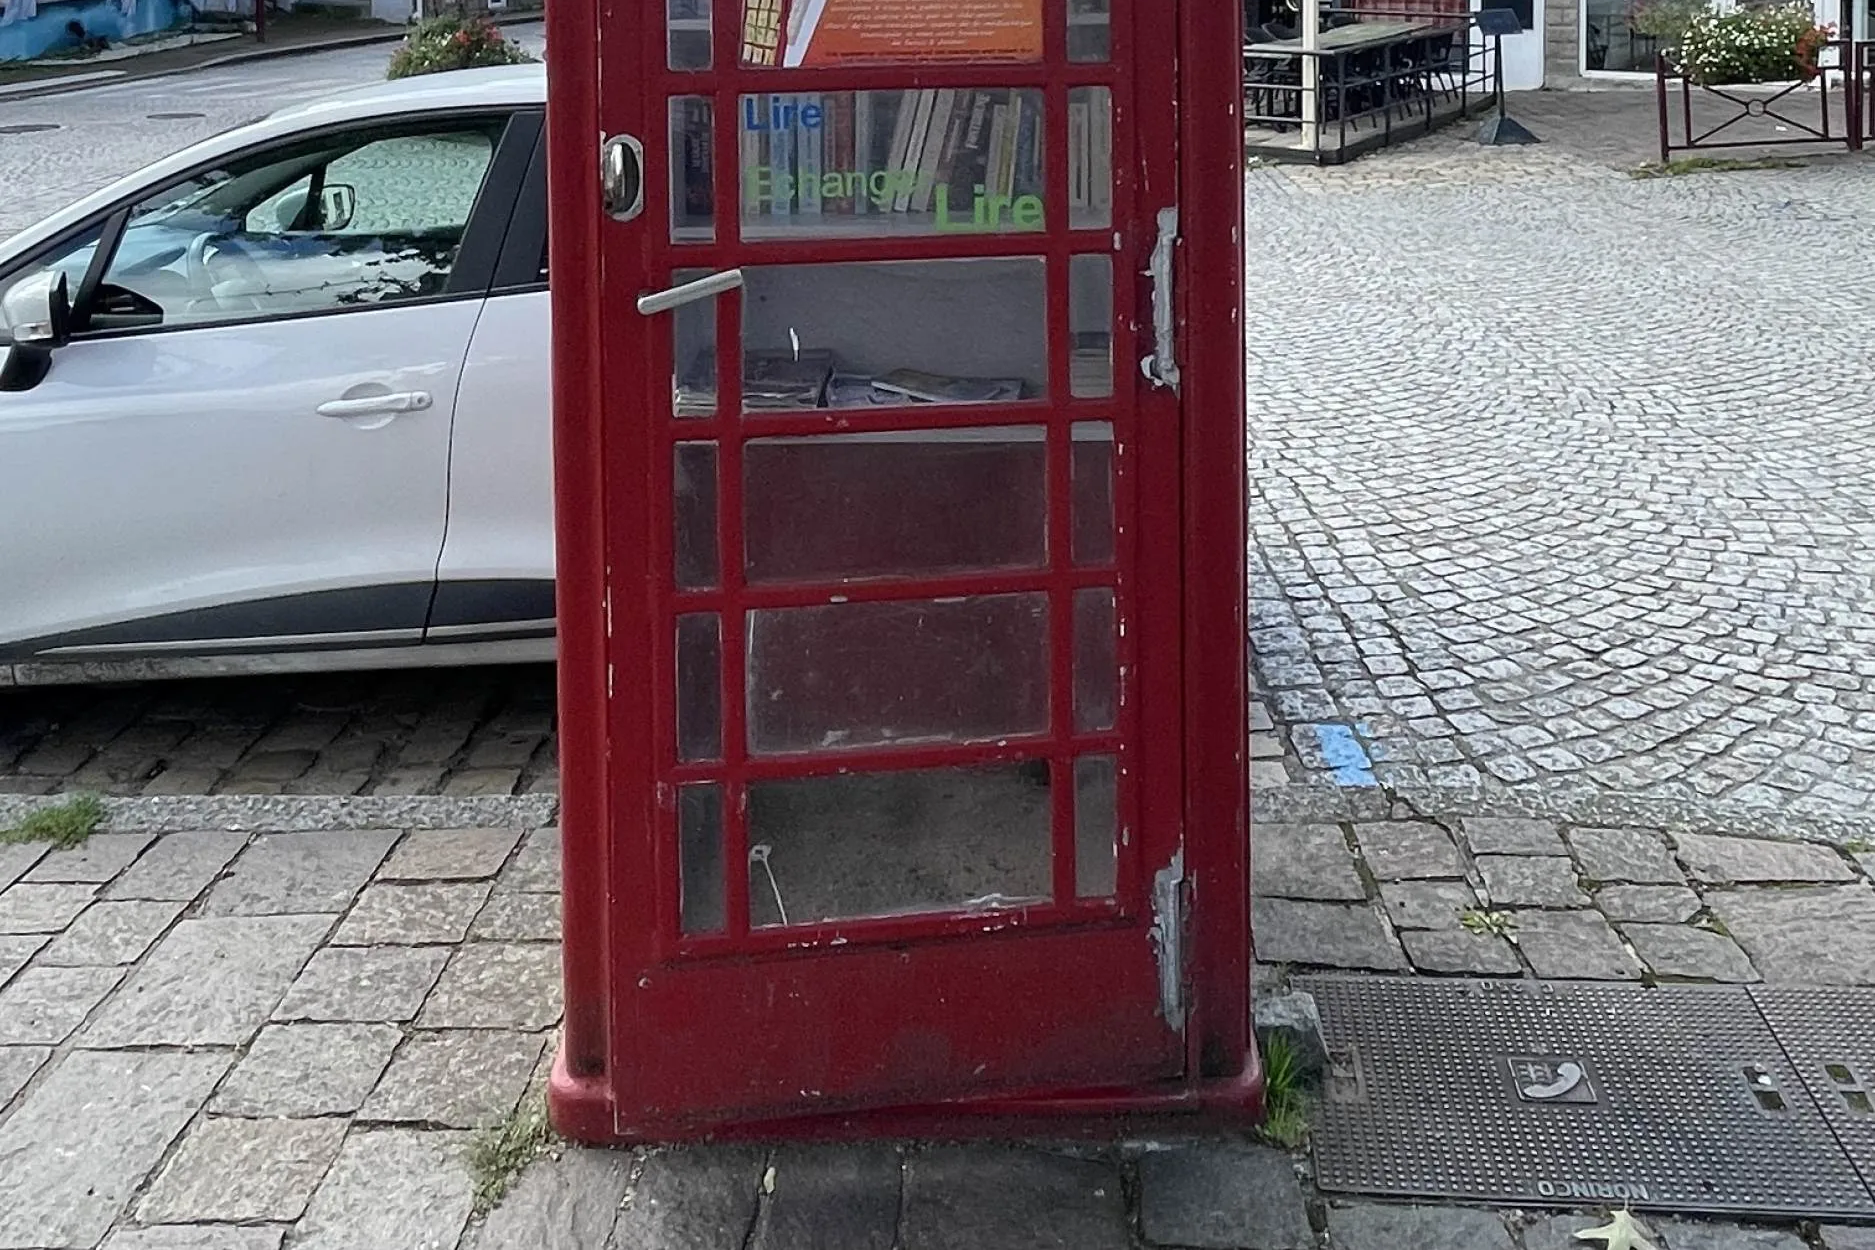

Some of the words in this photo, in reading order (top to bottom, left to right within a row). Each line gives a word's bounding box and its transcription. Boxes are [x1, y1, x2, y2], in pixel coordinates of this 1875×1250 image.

[746, 96, 823, 130] Lire
[935, 182, 1045, 231] Lire
[1537, 1180, 1650, 1200] NORINCO
